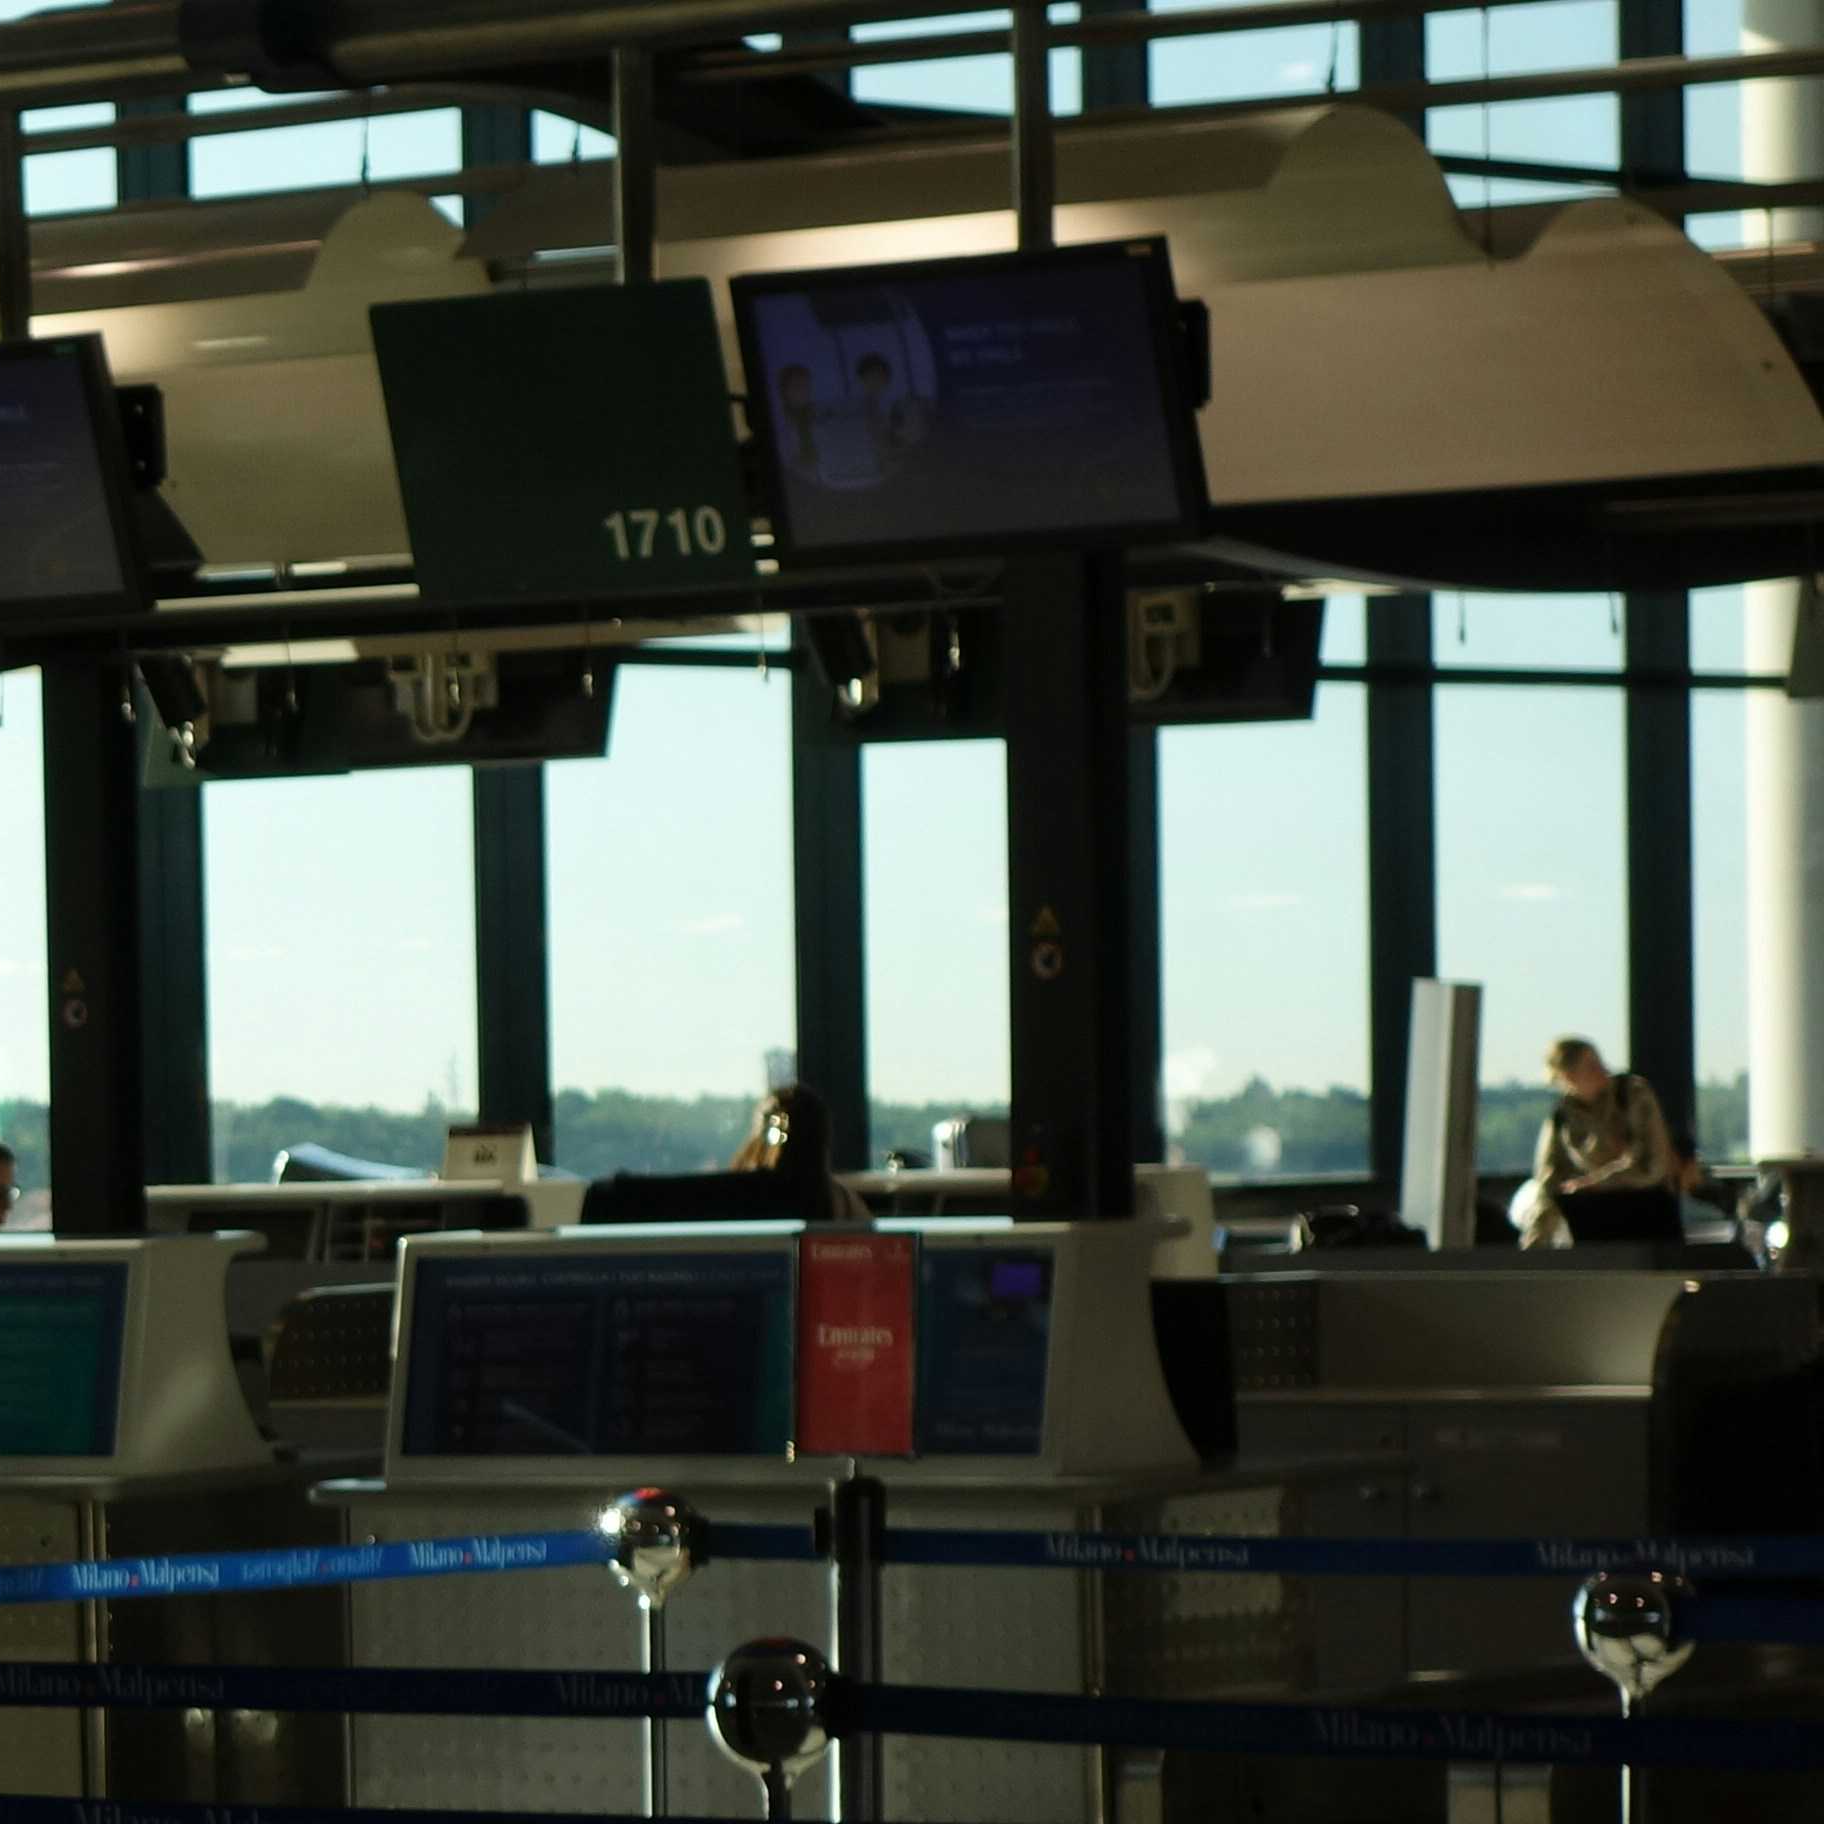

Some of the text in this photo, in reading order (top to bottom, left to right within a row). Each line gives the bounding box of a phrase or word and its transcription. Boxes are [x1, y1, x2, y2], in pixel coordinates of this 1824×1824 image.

[604, 505, 728, 560] 1710
[815, 1322, 896, 1349] Emirates
[406, 1536, 548, 1569] Milano Malpensa
[1043, 1535, 1249, 1569] Milano Malpensa
[1536, 1539, 1757, 1573] Milano Malpensa
[69, 1557, 220, 1593] Milano Malpensa
[95, 1664, 224, 1708] Malpensa
[553, 1673, 649, 1707] Milano
[1309, 1709, 1593, 1758] Milano Malpensa
